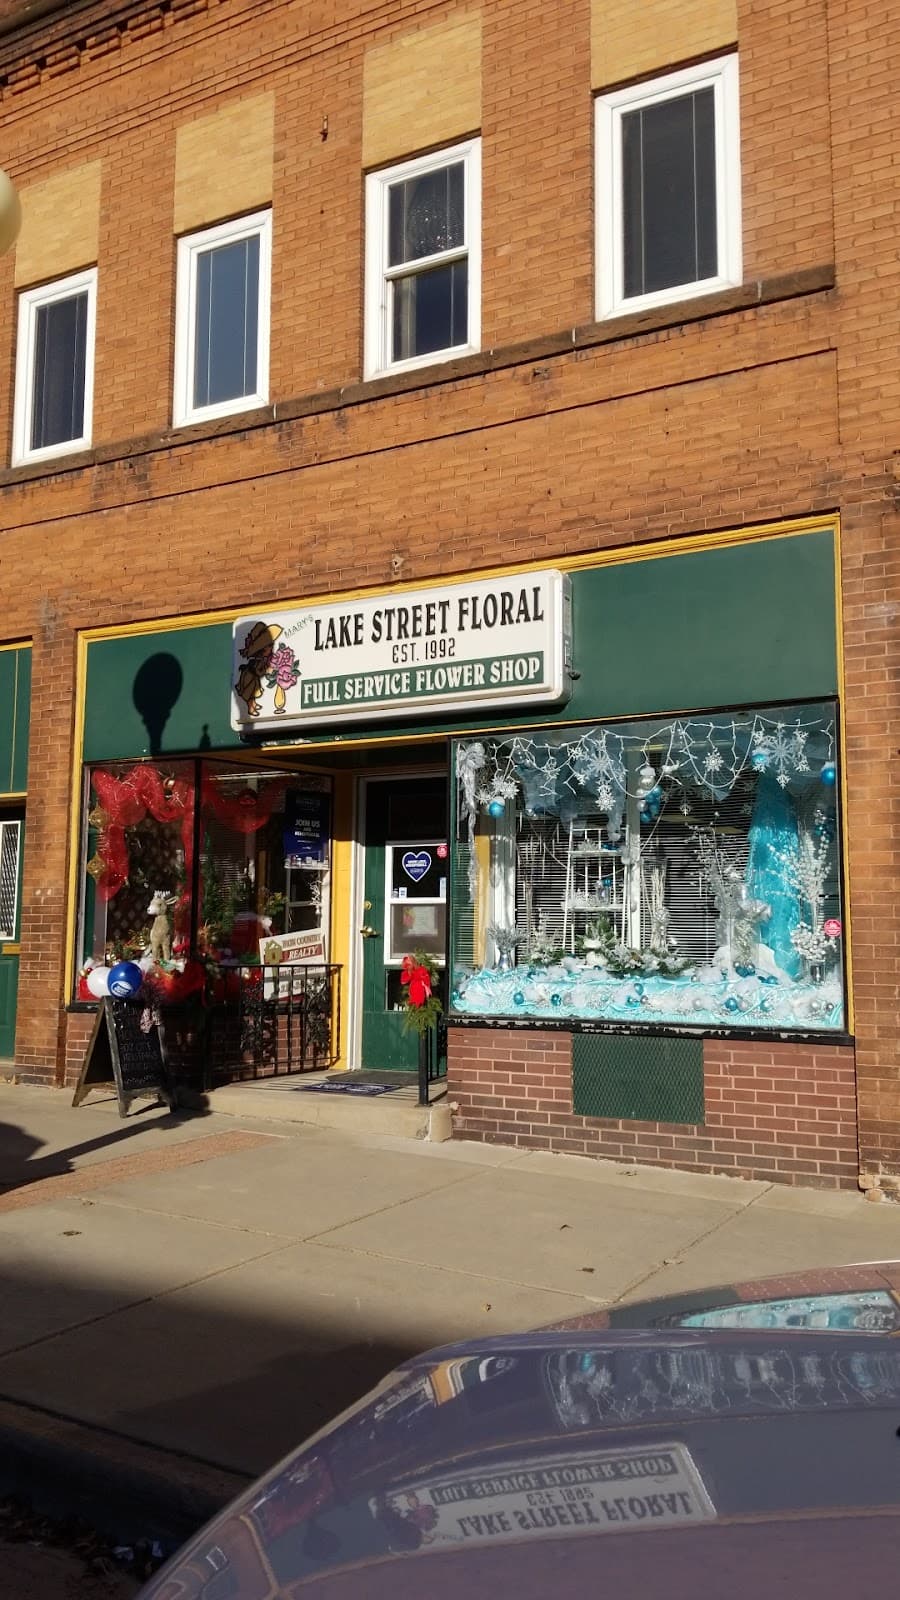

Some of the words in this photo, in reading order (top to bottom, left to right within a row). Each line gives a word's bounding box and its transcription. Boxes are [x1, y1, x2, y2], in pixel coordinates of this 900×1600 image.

[284, 614, 313, 639] MARY'S
[314, 613, 364, 651] LAKE
[371, 600, 450, 643] STREET
[458, 586, 544, 631] FLORAL
[392, 644, 419, 664] EST.
[425, 637, 455, 660] 1992
[304, 681, 340, 704] FULL
[345, 673, 410, 700] SERVICE
[416, 663, 486, 692] FLOWER
[490, 656, 540, 685] SHOP
[288, 945, 318, 961] REALTY
